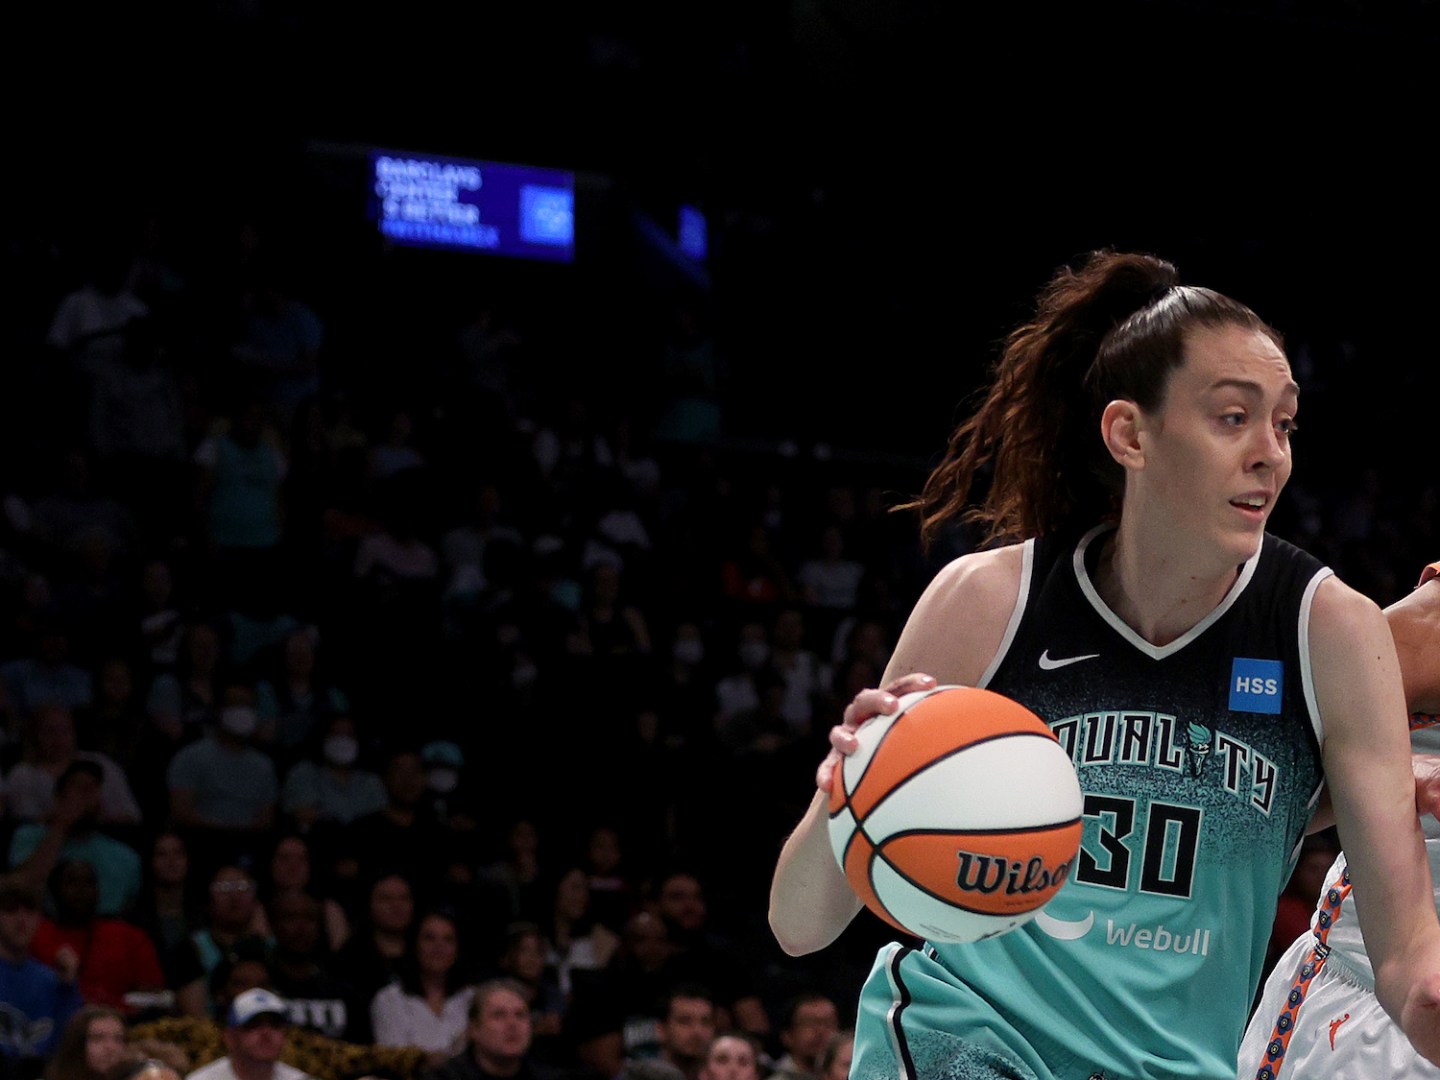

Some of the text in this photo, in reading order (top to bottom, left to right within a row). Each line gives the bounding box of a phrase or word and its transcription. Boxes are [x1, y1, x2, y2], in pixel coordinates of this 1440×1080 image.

[1235, 676, 1278, 696] HSS
[1075, 794, 1204, 899] 30
[956, 850, 1075, 895] Wilso
[1106, 919, 1212, 957] Webull
